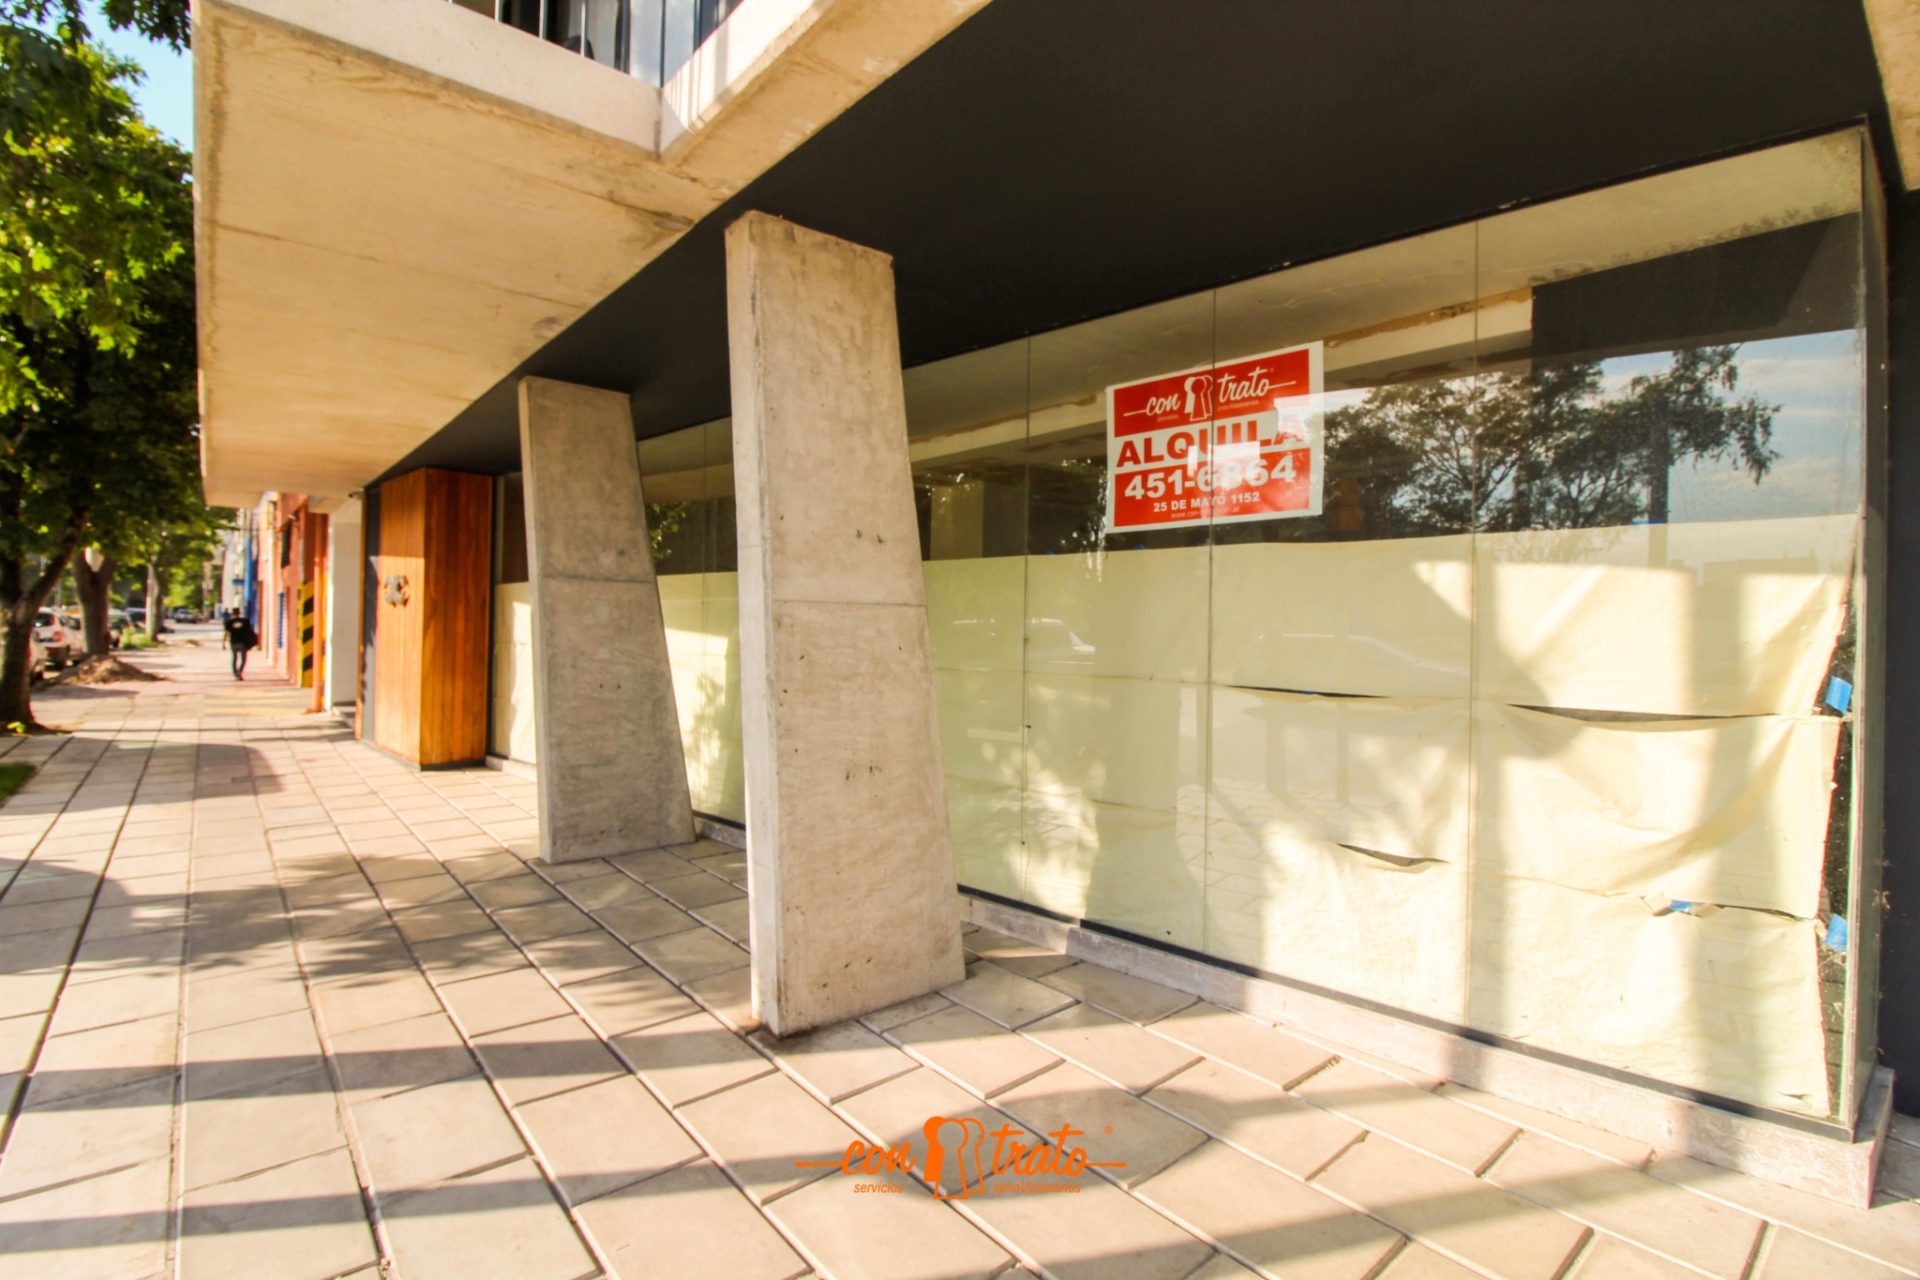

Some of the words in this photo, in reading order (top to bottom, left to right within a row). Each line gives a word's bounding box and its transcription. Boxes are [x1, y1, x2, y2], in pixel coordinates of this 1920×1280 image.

[1144, 393, 1181, 416] con
[1217, 366, 1269, 403] trato
[1153, 502, 1168, 513] 25
[1171, 500, 1187, 511] DE
[1191, 495, 1225, 508] MAYO
[1231, 491, 1261, 504] 1152
